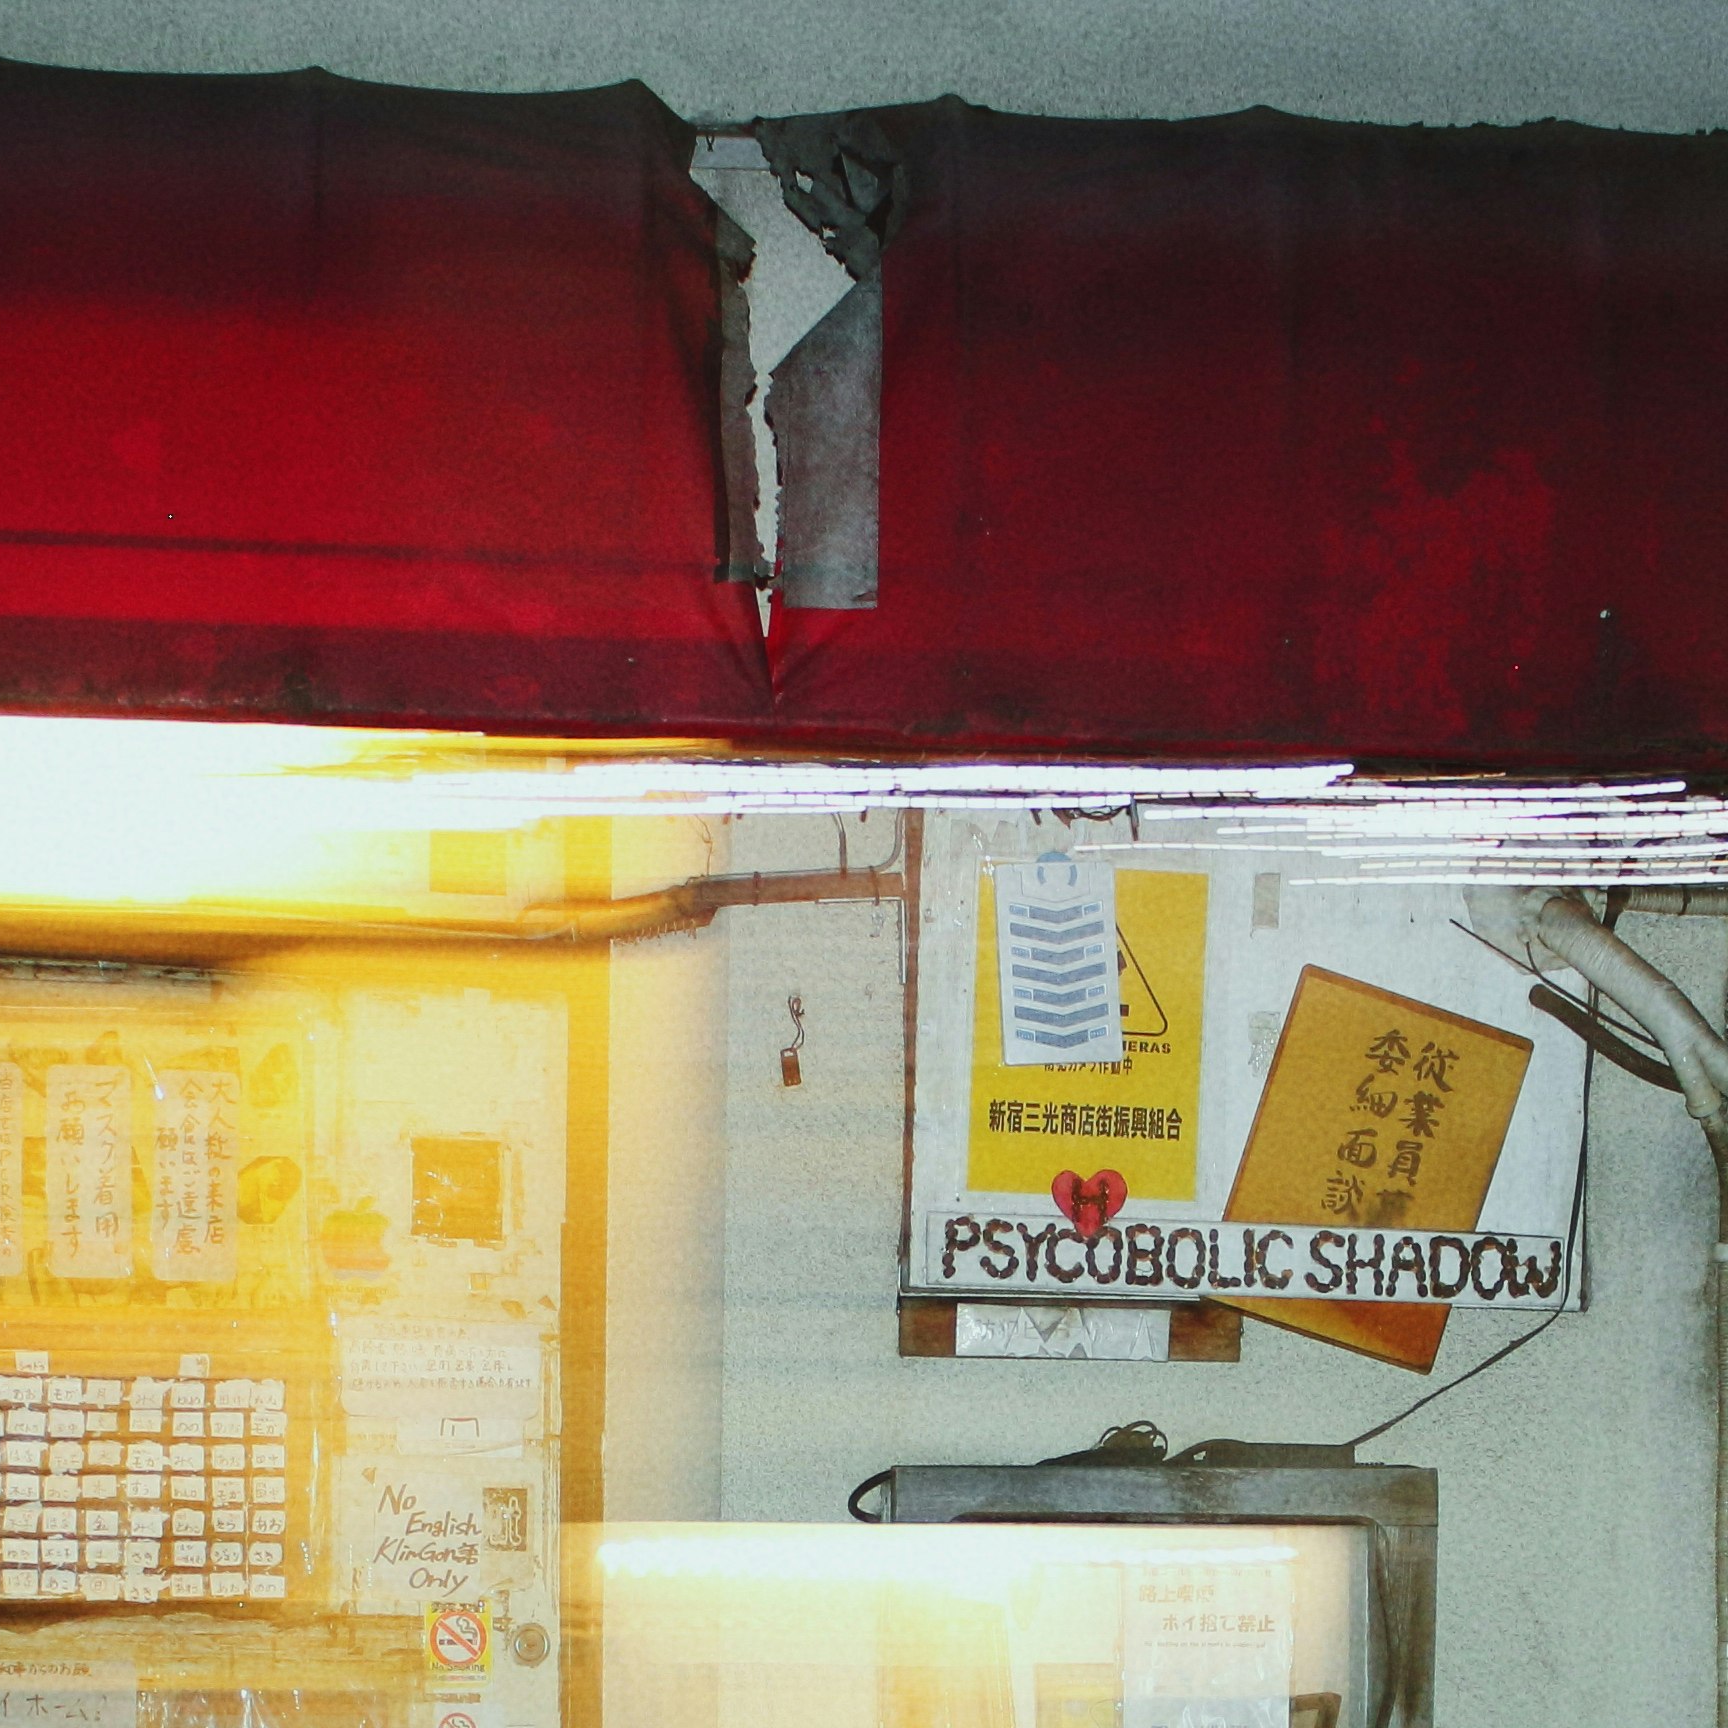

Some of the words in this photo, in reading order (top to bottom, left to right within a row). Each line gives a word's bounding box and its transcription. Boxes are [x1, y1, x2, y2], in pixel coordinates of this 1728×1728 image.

[989, 1100, 1183, 1141] 新宿三光商店街振興組合
[1322, 1029, 1411, 1221] 委細面談
[56, 1090, 86, 1258] お願いします
[95, 1080, 119, 1237] マスク着用
[944, 1215, 1294, 1291] PSYCOBOLIC
[1305, 1231, 1563, 1301] SHADOW
[378, 1484, 417, 1515] No
[405, 1511, 483, 1538] English
[409, 1567, 469, 1598] Only
